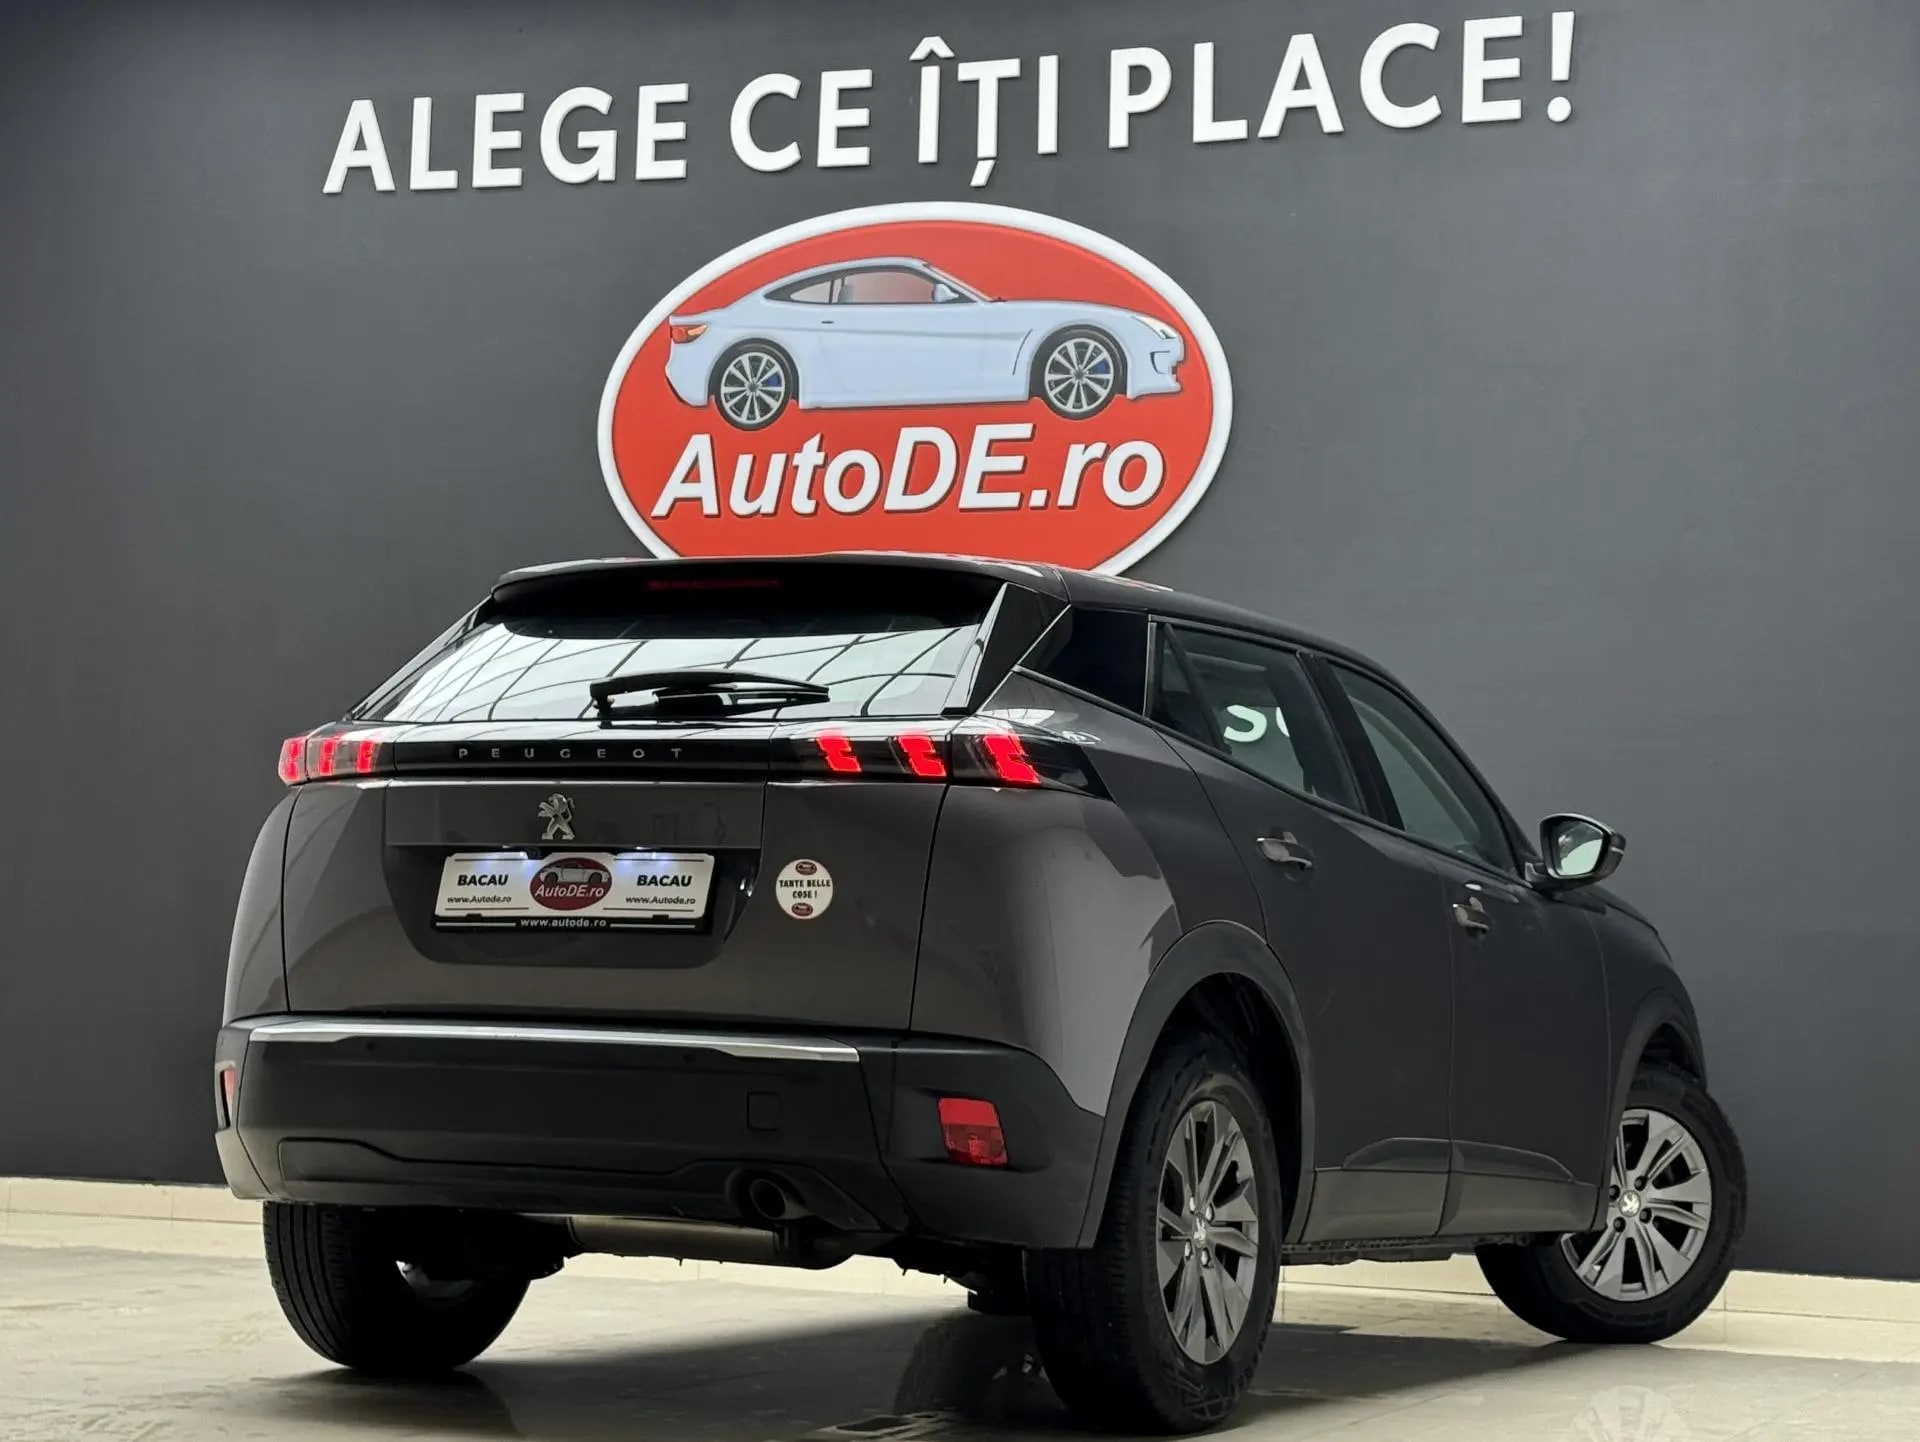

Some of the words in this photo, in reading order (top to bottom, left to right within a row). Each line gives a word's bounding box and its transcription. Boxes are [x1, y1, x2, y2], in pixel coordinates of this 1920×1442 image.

[322, 82, 690, 194] ALEGE
[729, 68, 873, 172] CE
[1108, 11, 1575, 149] PLACE!
[651, 423, 1164, 518] AutoDE.ro
[458, 747, 683, 760] PEUGEOT
[457, 874, 508, 886] BACAU
[636, 874, 692, 887] BACAU
[779, 879, 804, 888] TANTE
[806, 879, 831, 888] BELLE
[534, 883, 605, 898] AutoDE.ro
[792, 890, 812, 899] COSE
[447, 894, 512, 904] www.Autode.ro
[625, 894, 697, 905] www.Autode.ro
[520, 917, 607, 928] www.autode.ro
